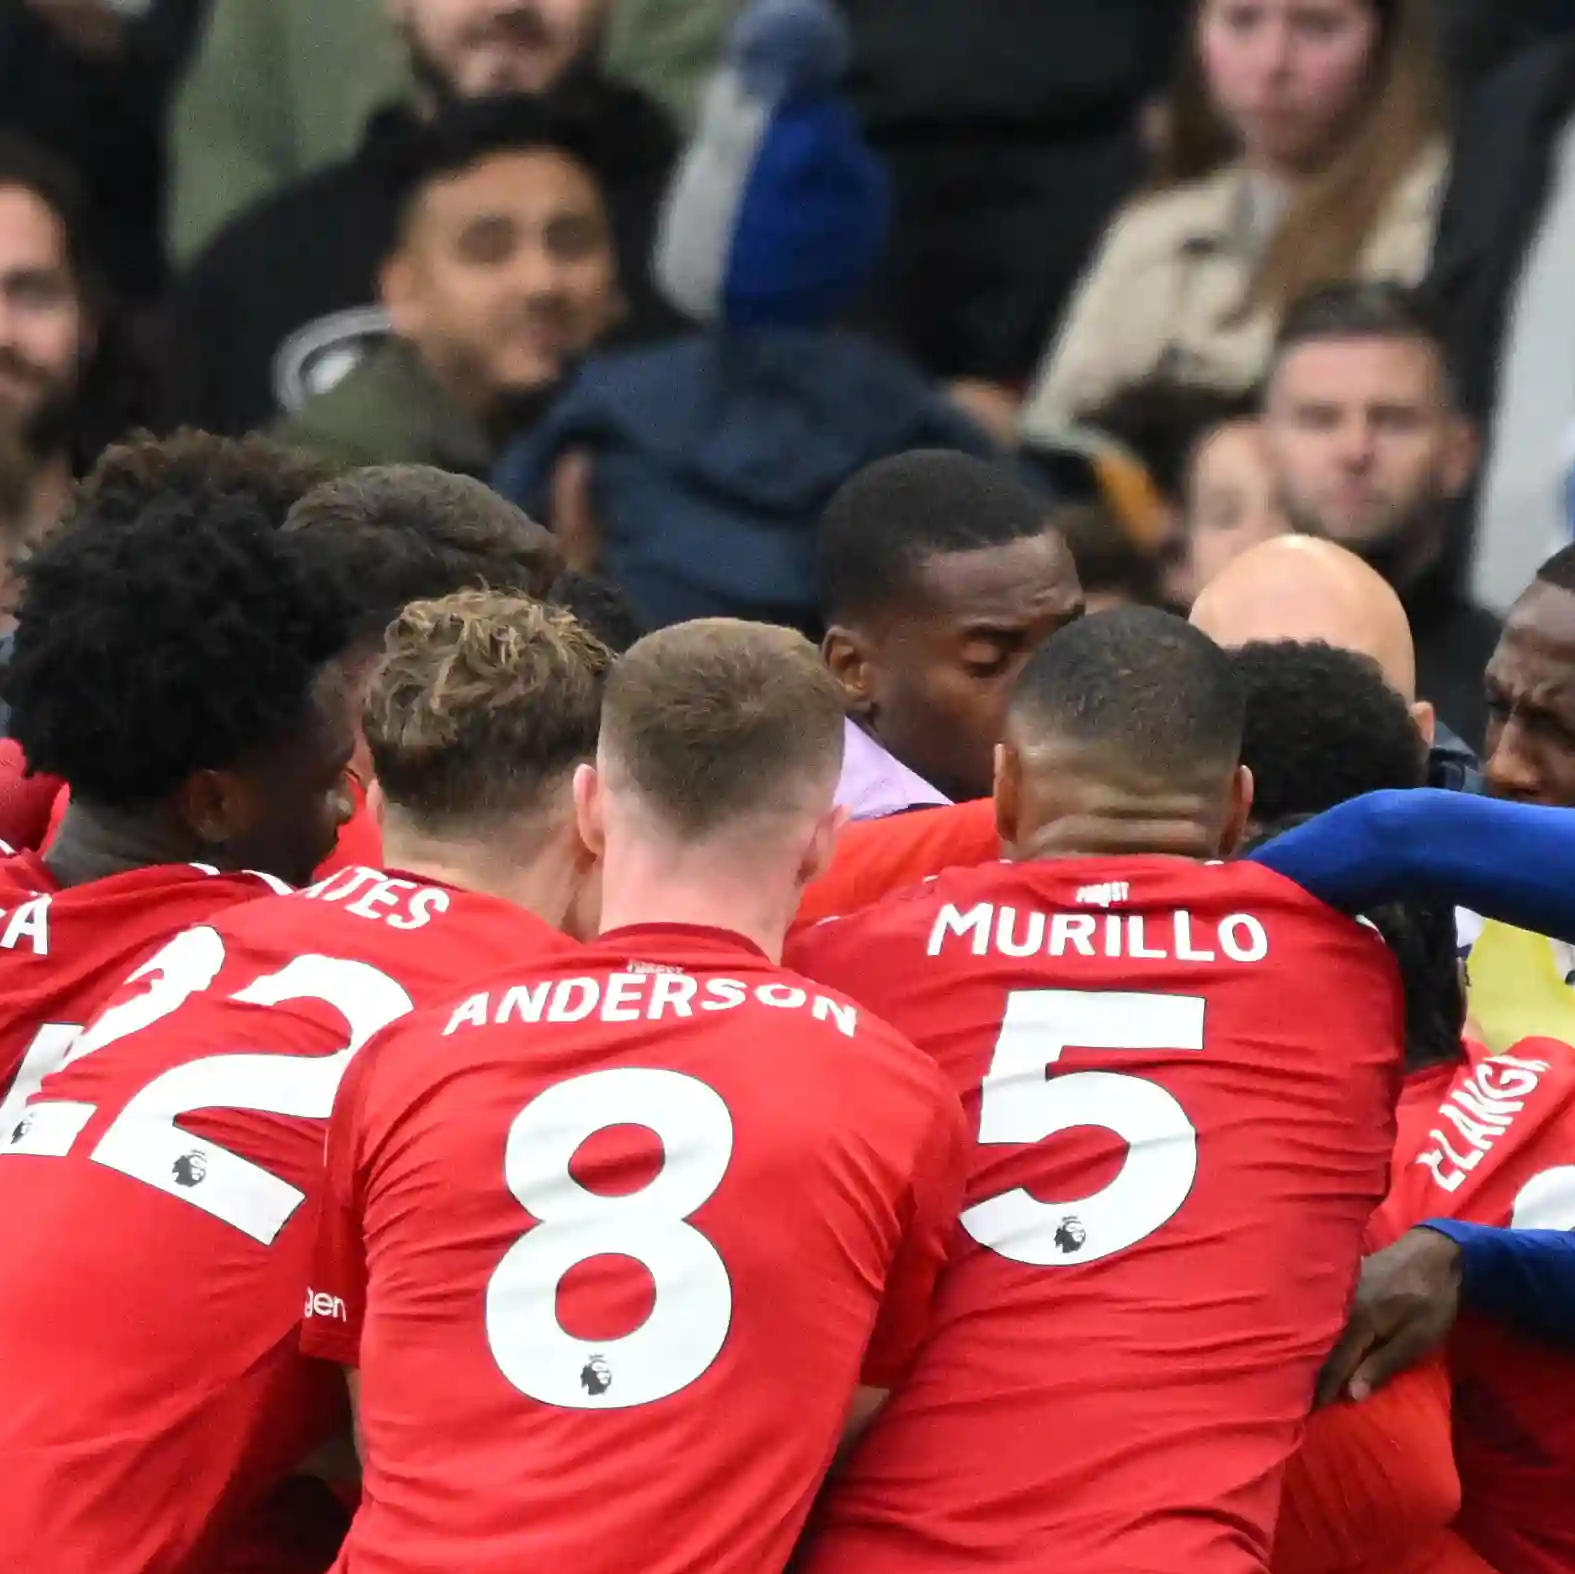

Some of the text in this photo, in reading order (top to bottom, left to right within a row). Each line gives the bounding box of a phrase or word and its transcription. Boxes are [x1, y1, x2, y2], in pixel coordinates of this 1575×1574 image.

[440, 973, 860, 1038] ANDERSON
[926, 901, 1269, 963] MURILLO
[957, 989, 1207, 1267] 5
[485, 1066, 735, 1410] 8
